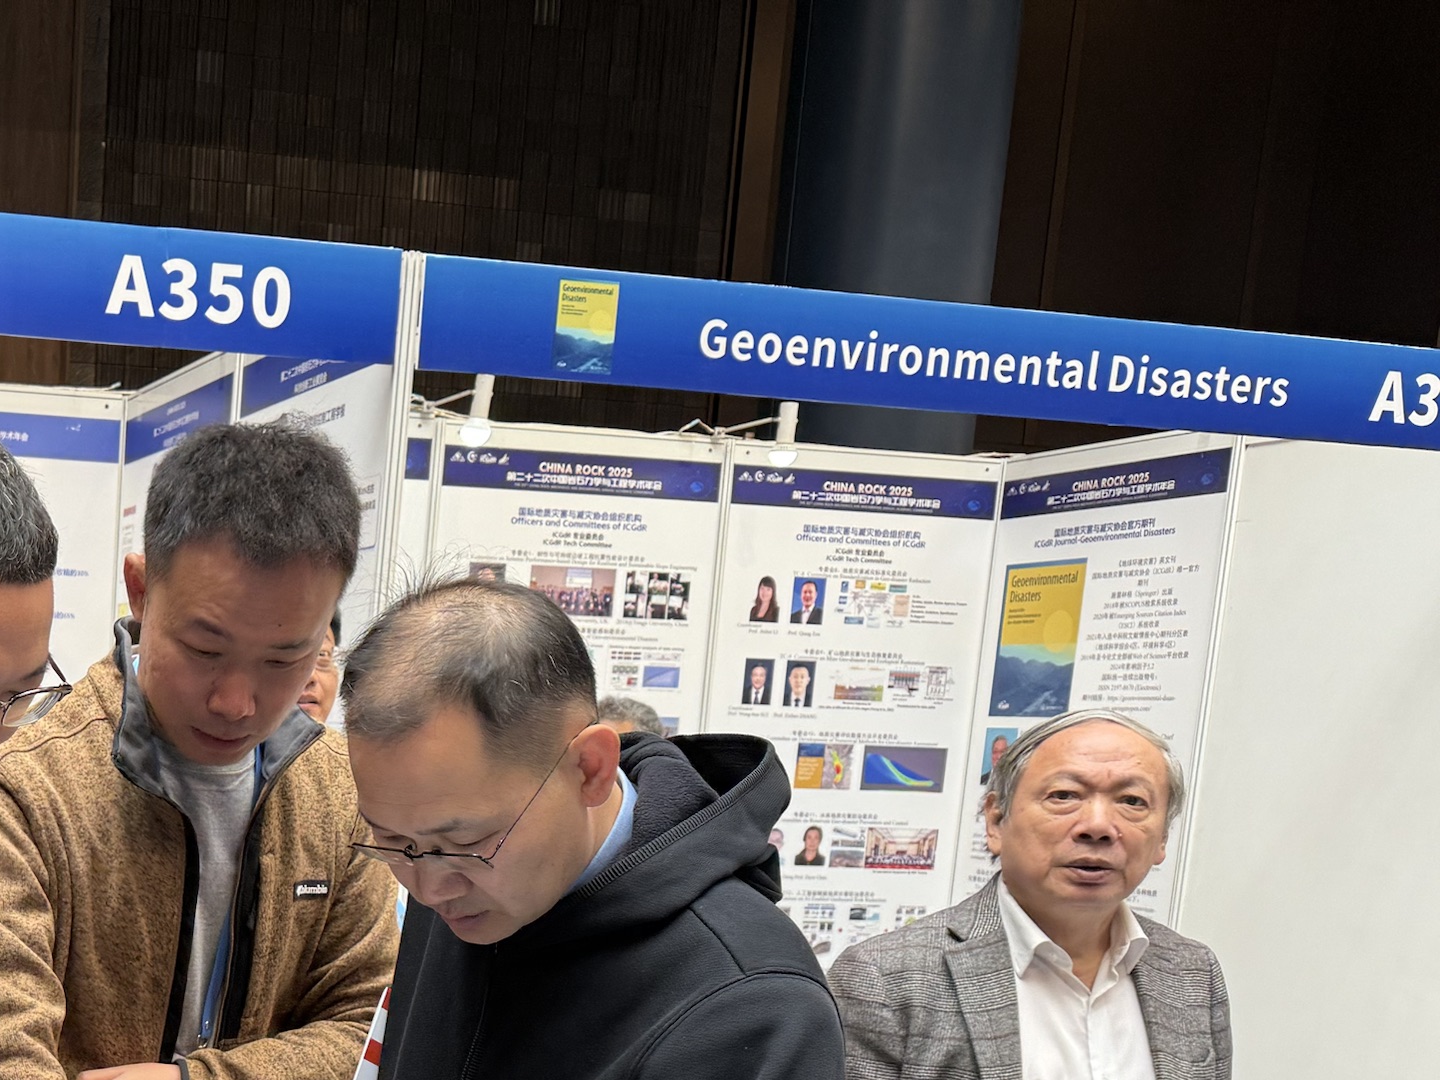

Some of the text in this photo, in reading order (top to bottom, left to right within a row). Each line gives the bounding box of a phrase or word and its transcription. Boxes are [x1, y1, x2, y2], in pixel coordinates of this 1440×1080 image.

[105, 254, 291, 329] A350
[561, 293, 587, 303] Disasters
[562, 283, 615, 296] Geoenvironmental
[699, 318, 1290, 407] Geoenvironmental Disasters
[539, 461, 633, 478] CHINA ROCK 2025
[506, 471, 663, 492] 第二十二次中国岩石力学与工程学术年会
[823, 480, 913, 497] CHINA ROCK 2025
[1072, 471, 1150, 493] CHINA ROCK 2025
[792, 490, 941, 510] 第二十二次中国岩石力学与工程学术年会
[1046, 479, 1176, 506] 第二十二次中国岩石力学与工程学术年会
[510, 516, 648, 532] Officers and Committees of ICGdR
[1054, 517, 1156, 538] 国际地质灾害与减灾协会官方期刊
[1143, 526, 1176, 537] Disasters
[578, 540, 613, 550] Committee
[796, 533, 926, 549] Officers and Committees of ICGdR
[860, 556, 893, 566] Committee
[1011, 570, 1079, 588] Geoenvironmental
[1009, 589, 1042, 603] Disasters
